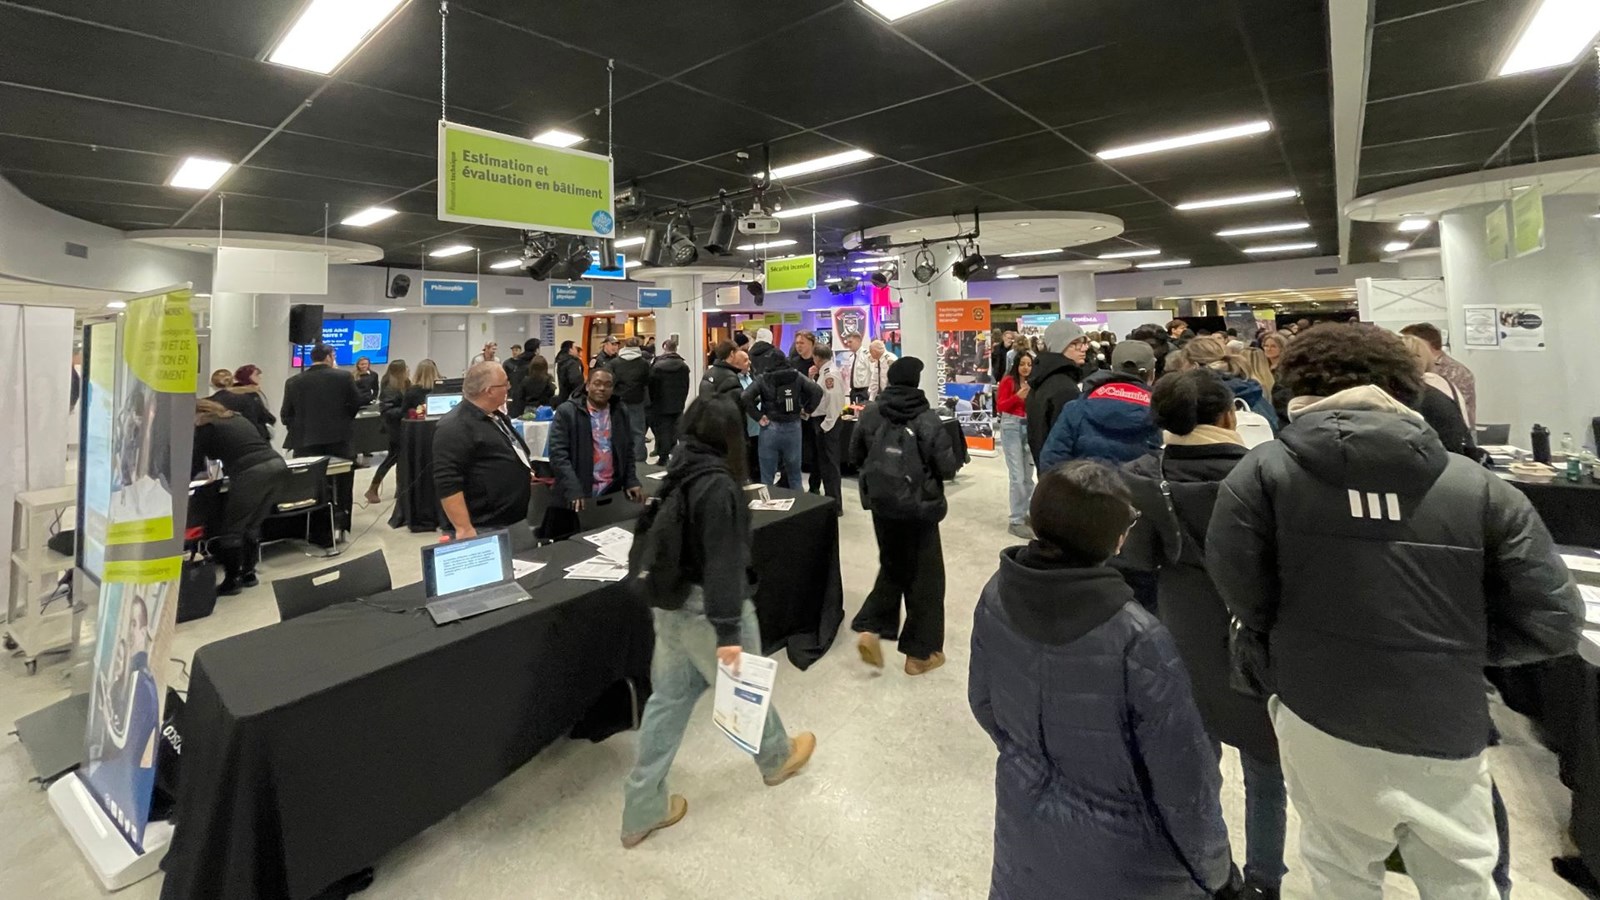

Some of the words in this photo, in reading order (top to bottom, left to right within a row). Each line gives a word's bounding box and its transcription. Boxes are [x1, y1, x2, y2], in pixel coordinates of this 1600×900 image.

[462, 149, 534, 173] Estimation
[536, 165, 549, 177] et
[462, 165, 532, 188] évaluation
[535, 179, 550, 190] en
[553, 180, 603, 200] bâtiment
[791, 262, 810, 270] incendie
[431, 284, 463, 292] Philosophie
[936, 342, 947, 408] NTMORENCY
